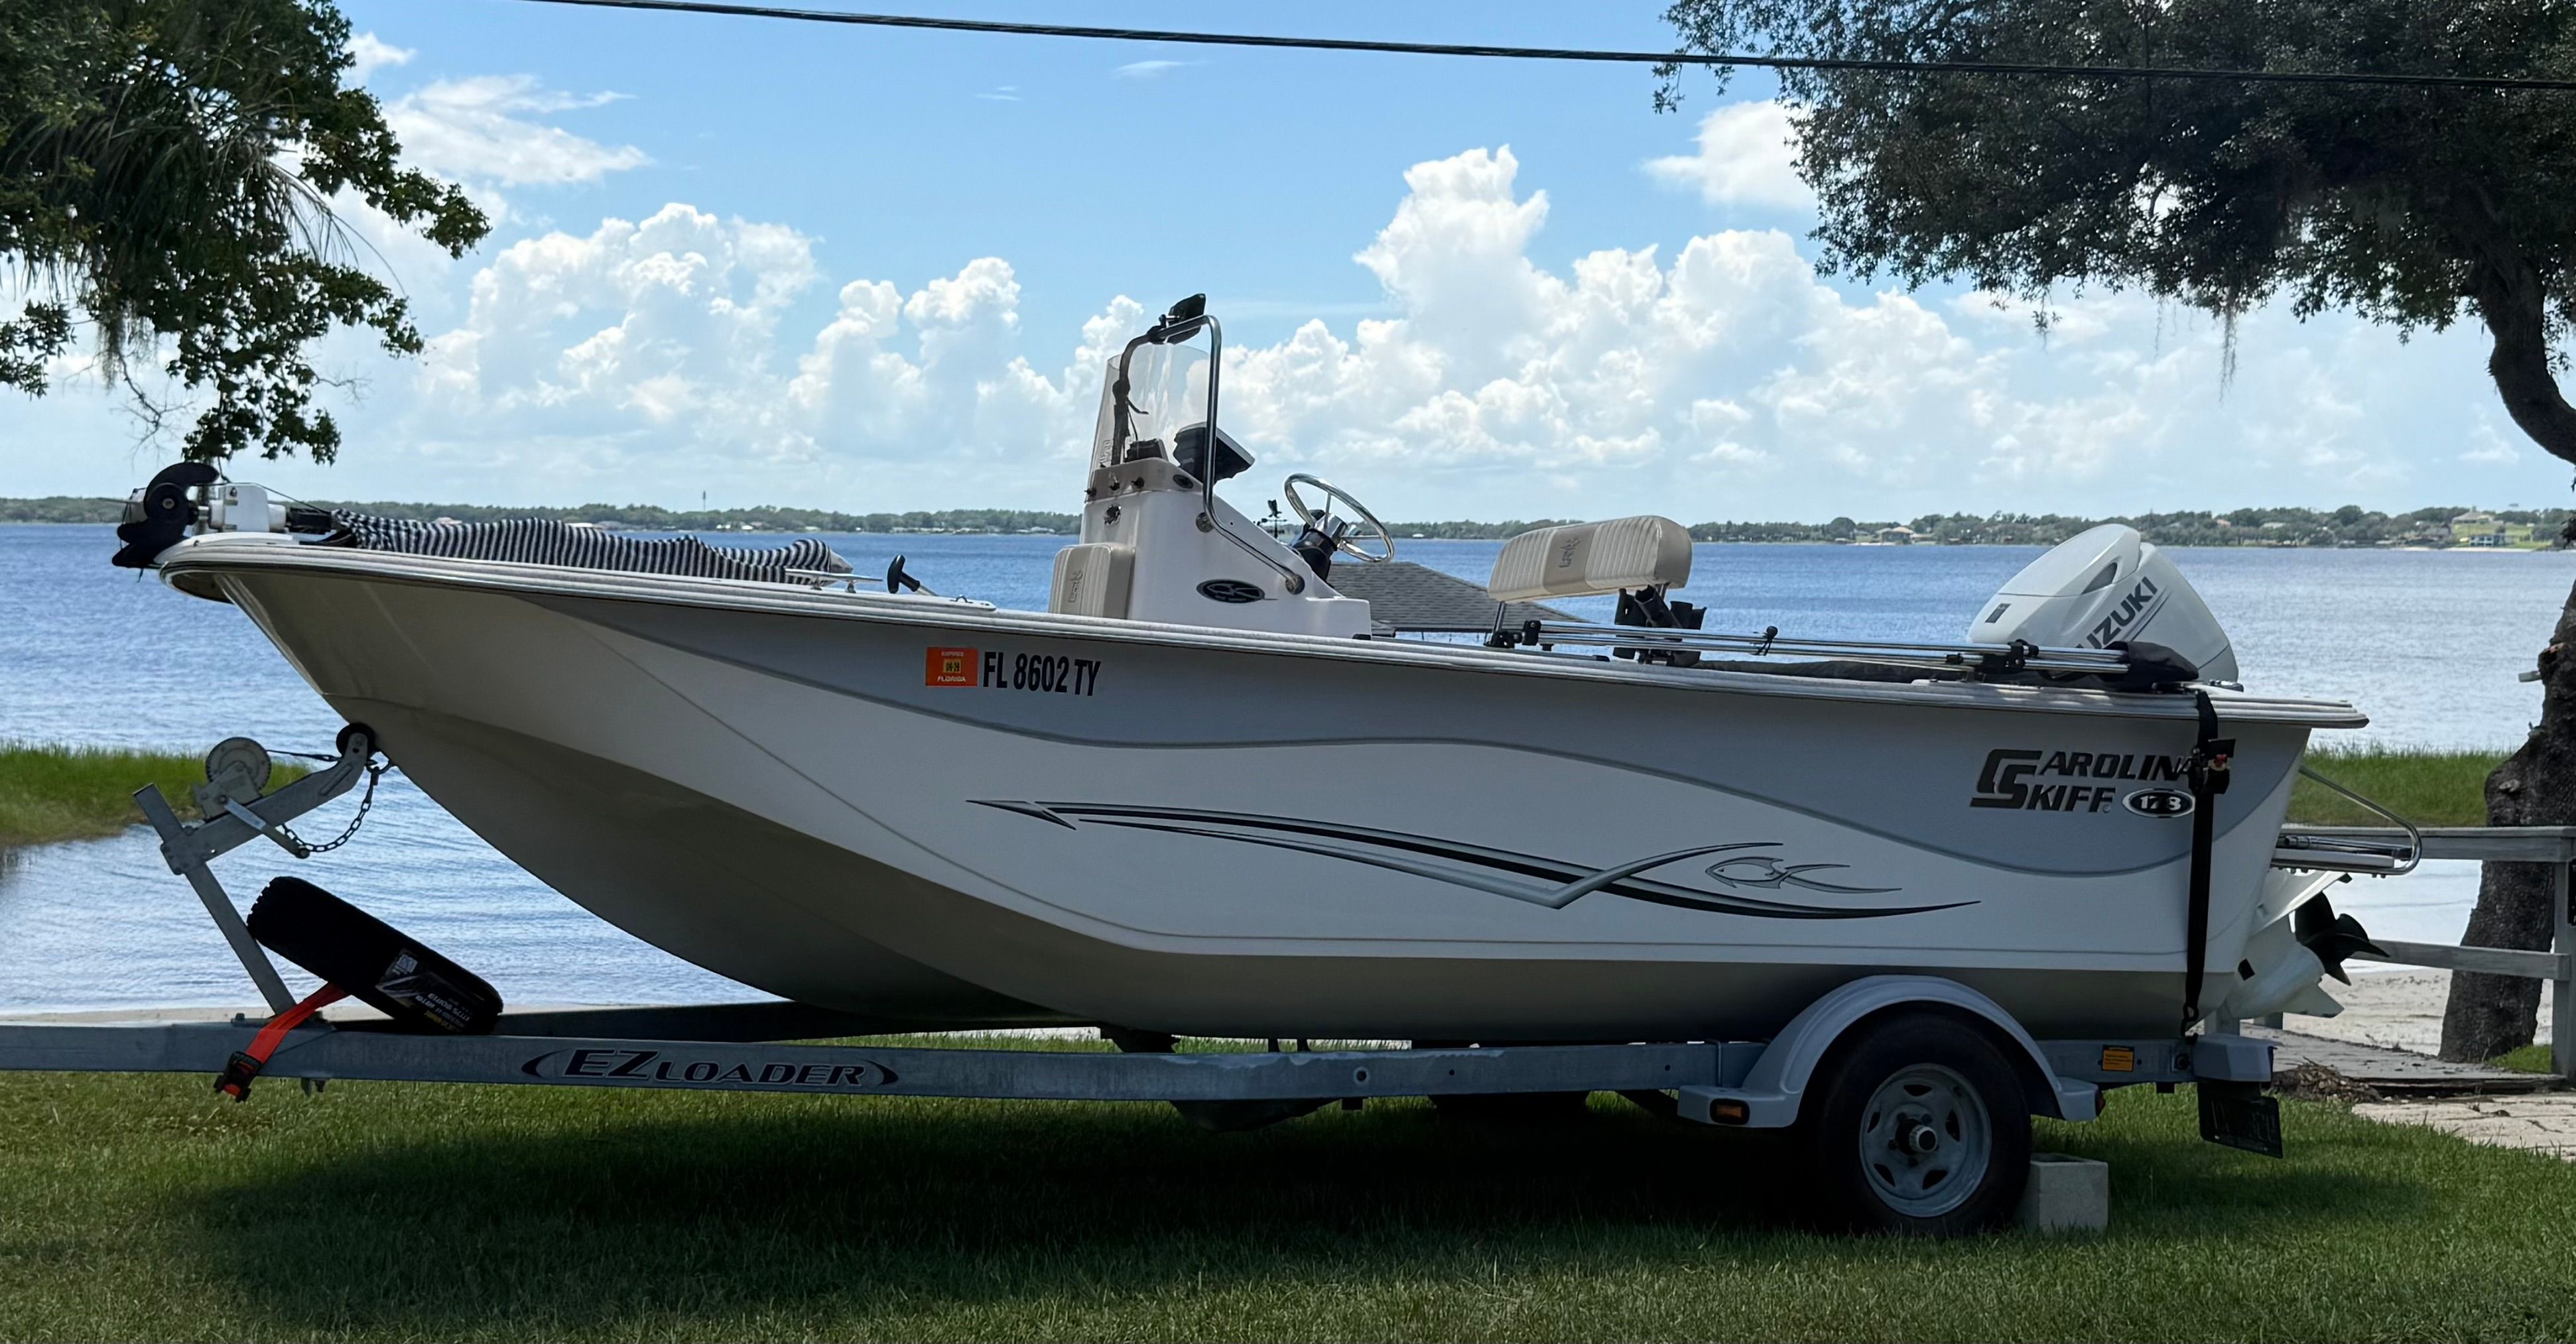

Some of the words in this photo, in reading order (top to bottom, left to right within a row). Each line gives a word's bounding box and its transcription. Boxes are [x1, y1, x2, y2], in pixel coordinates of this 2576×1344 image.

[2075, 576, 2158, 650] ZUKI
[983, 651, 1007, 688] FL
[1013, 653, 1068, 694] 8602
[1074, 658, 1101, 696] TY
[1970, 764, 2116, 813] SKIFF
